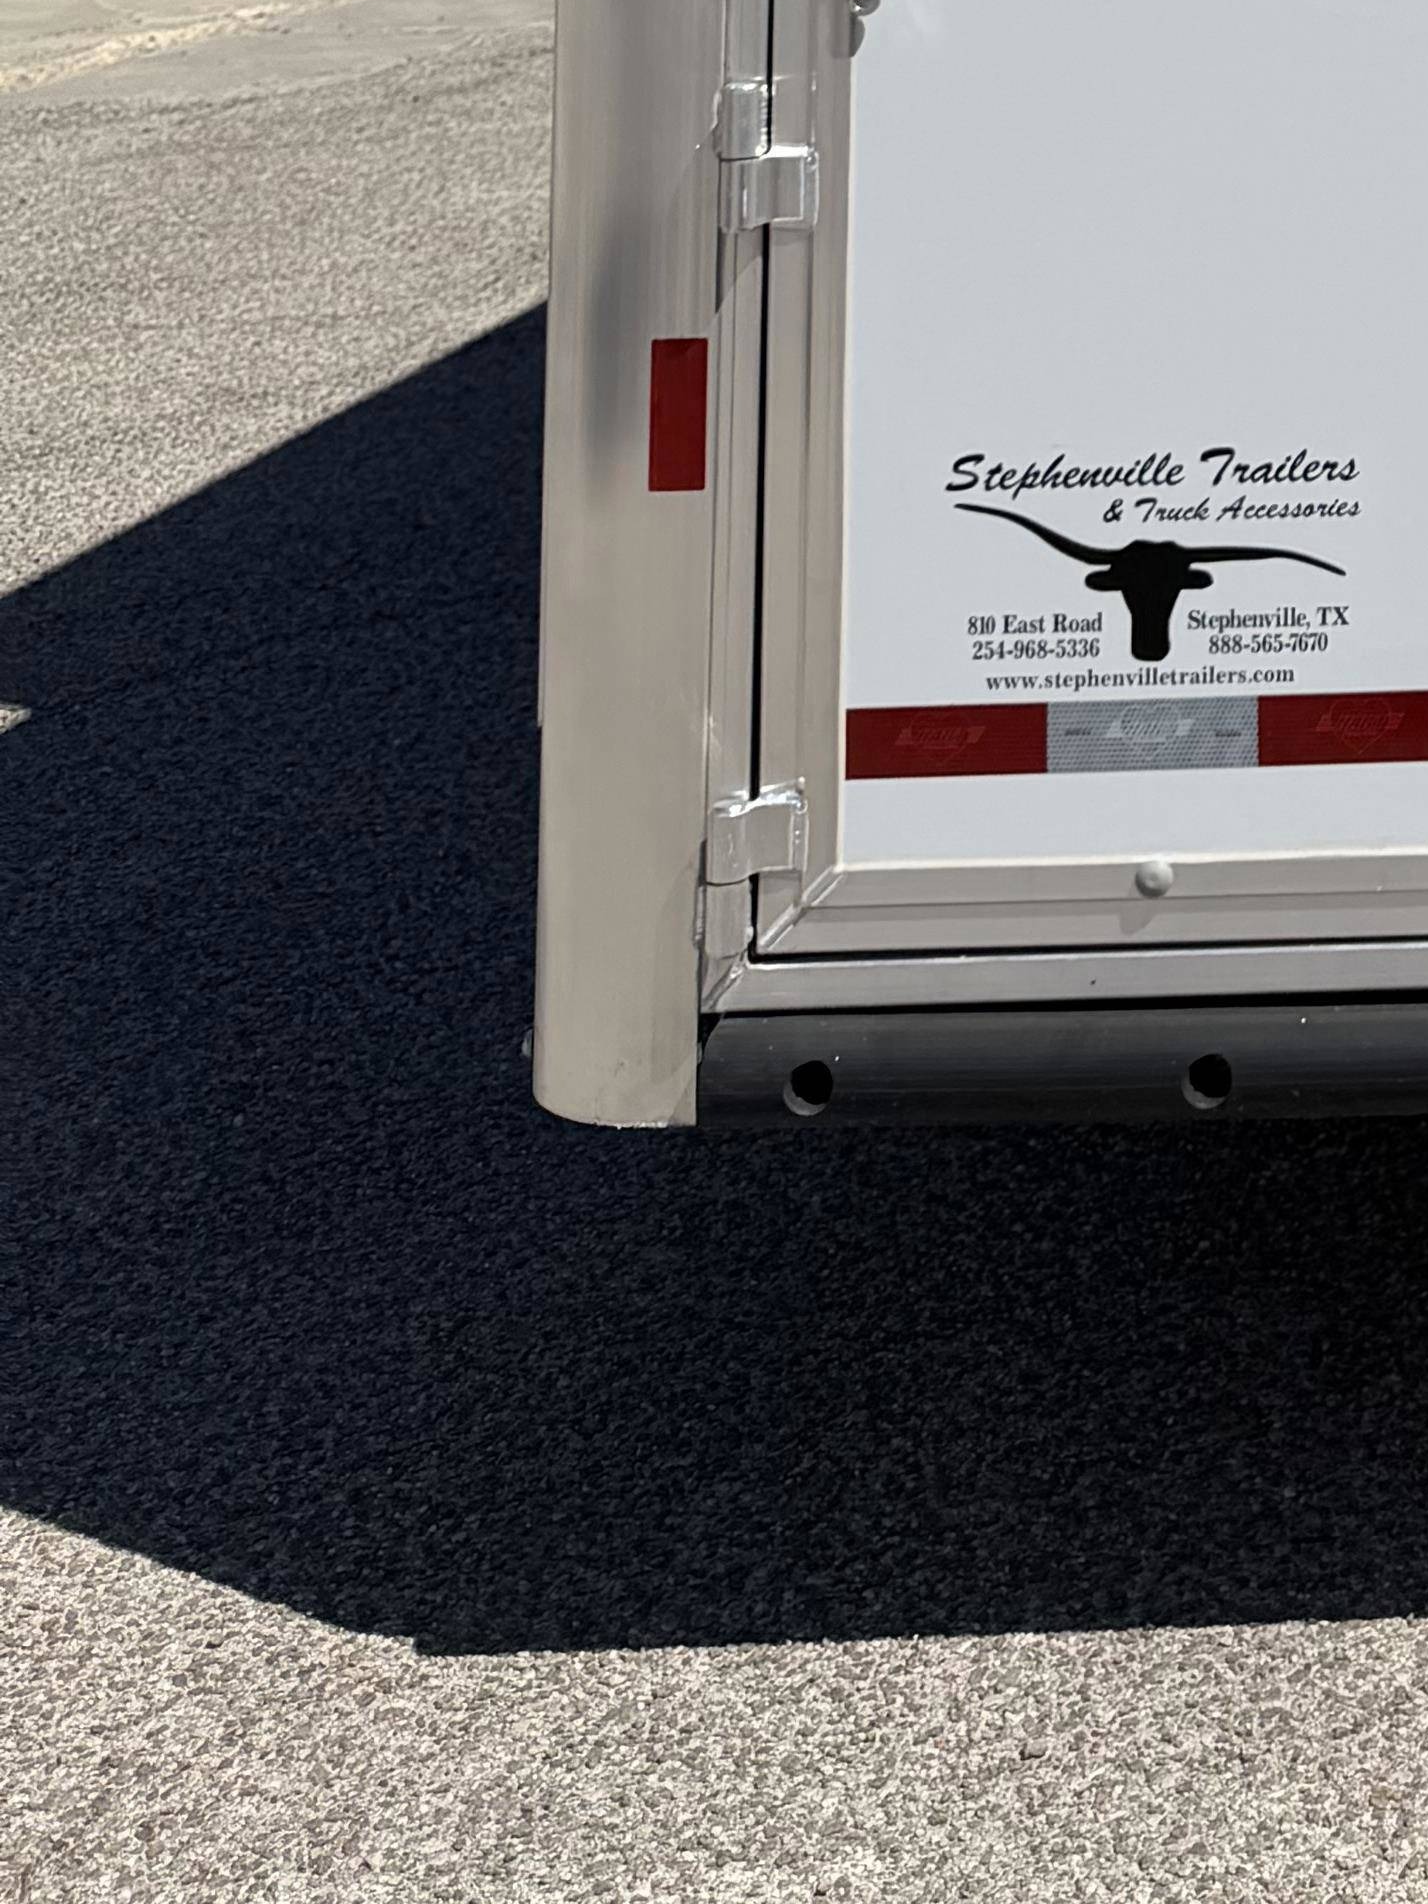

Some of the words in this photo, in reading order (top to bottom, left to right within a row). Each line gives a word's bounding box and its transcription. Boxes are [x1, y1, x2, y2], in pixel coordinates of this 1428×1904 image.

[945, 452, 1185, 499] Stephenville
[1200, 447, 1360, 487] Trailers
[1102, 498, 1124, 523] &
[1134, 497, 1210, 523] Truck
[1216, 495, 1361, 521] Accessories
[967, 616, 996, 635] 810
[1002, 615, 1046, 634] East
[1053, 611, 1103, 633] Road
[1187, 607, 1311, 633] Stephenville,
[1316, 606, 1349, 626] TX
[972, 638, 1101, 660] 254-968-5336
[1208, 632, 1329, 654] 888-565-7670
[985, 665, 1295, 692] www.stephenvilletrailers.com
